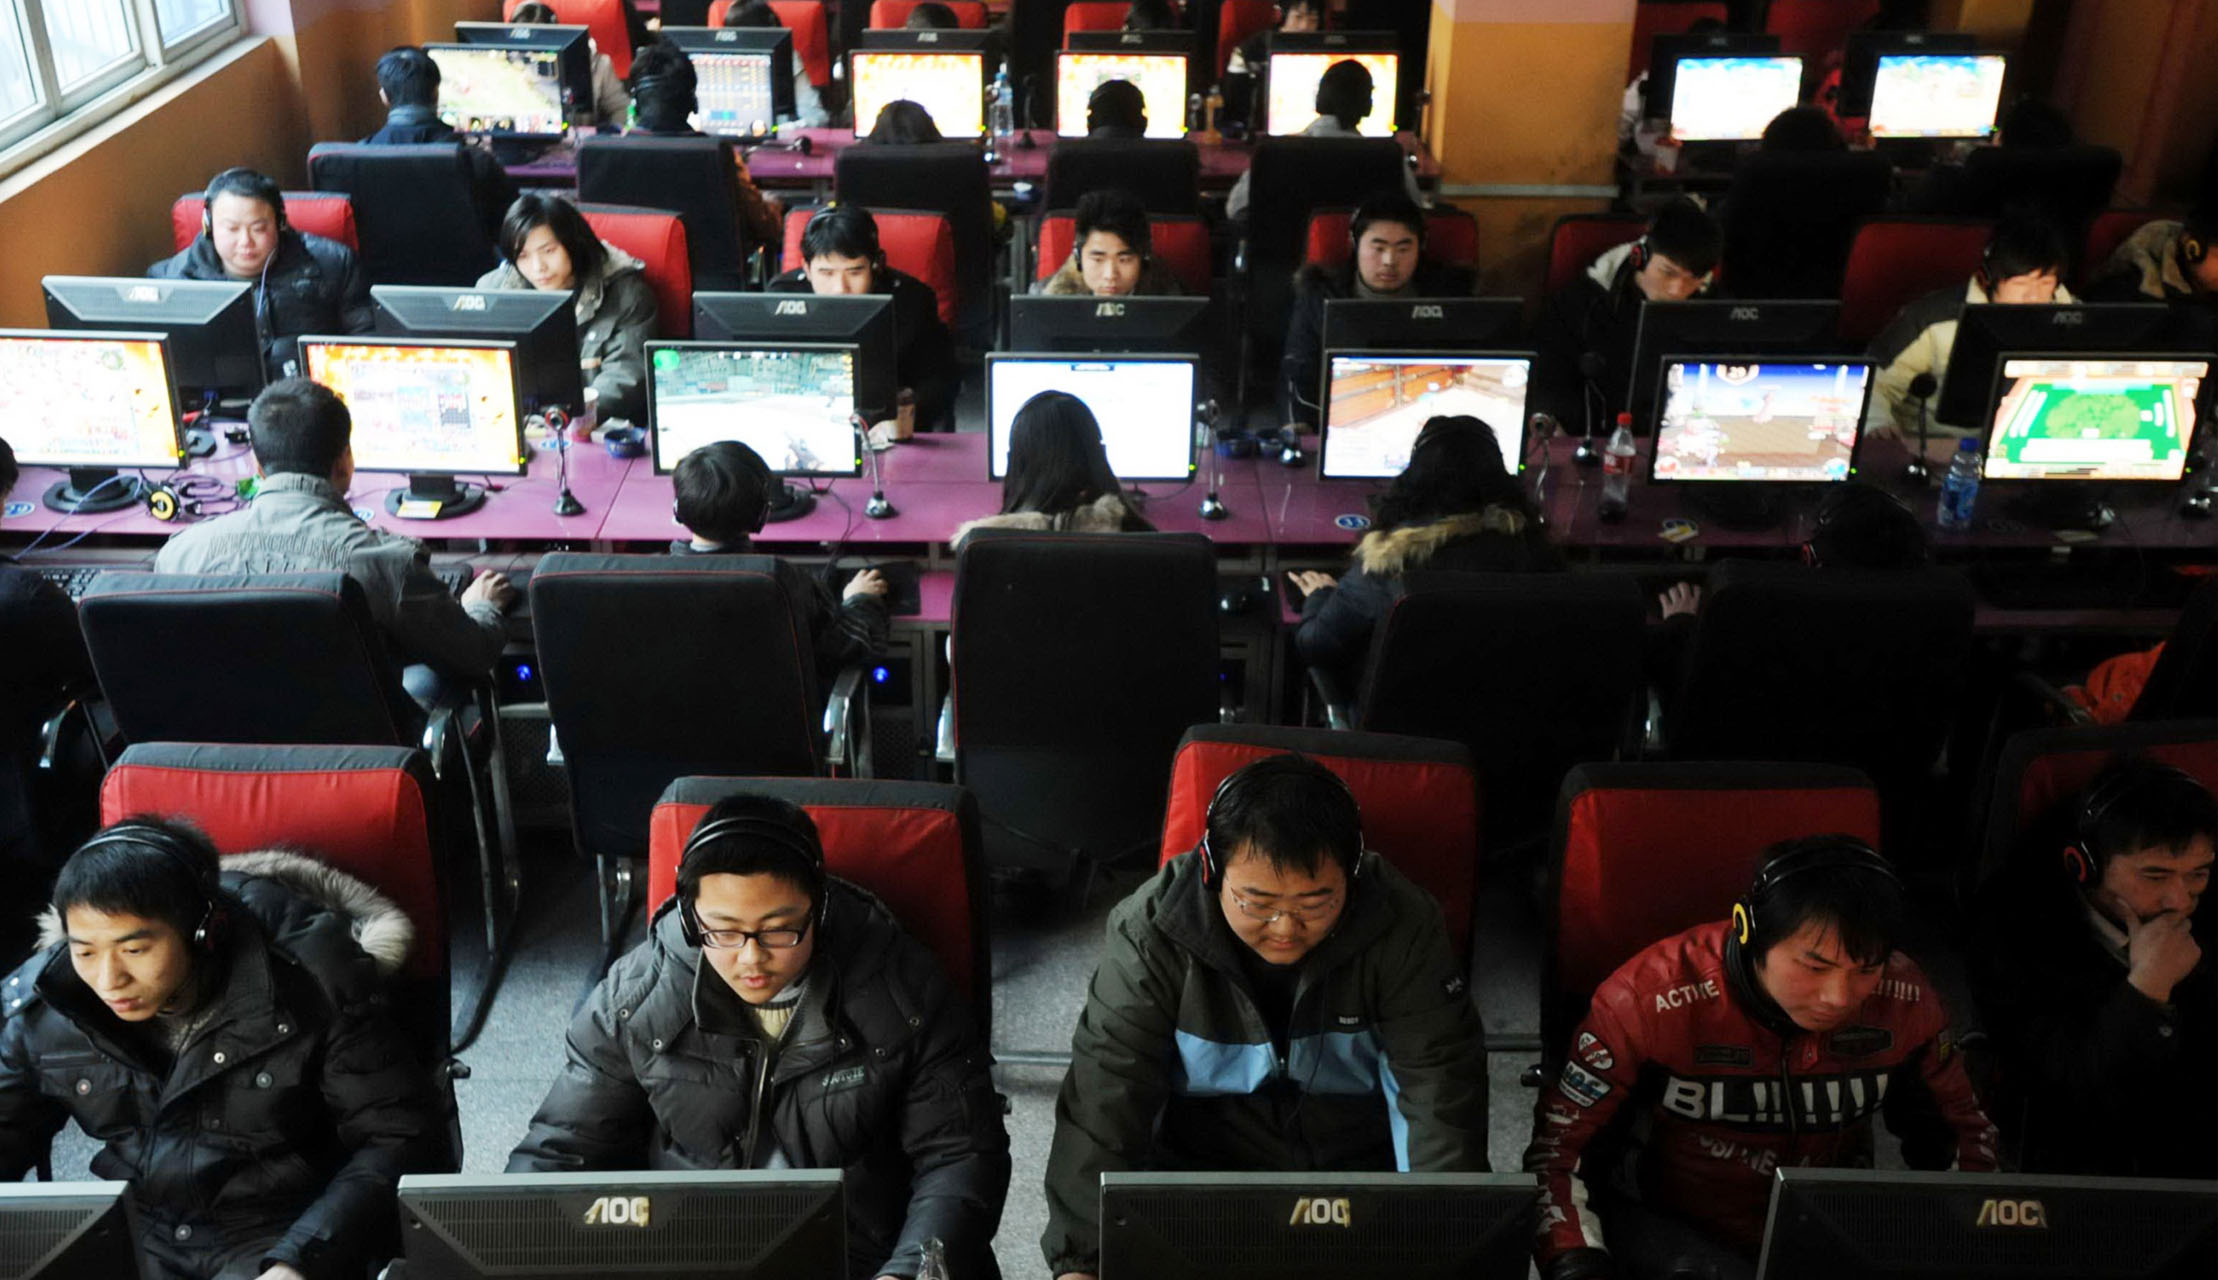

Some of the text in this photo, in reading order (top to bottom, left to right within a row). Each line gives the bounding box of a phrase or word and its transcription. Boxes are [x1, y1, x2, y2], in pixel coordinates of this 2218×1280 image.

[453, 294, 487, 311] AOC
[774, 300, 808, 316] AOC
[1411, 304, 1444, 319] AOC
[1729, 306, 1759, 321] AOC
[2052, 311, 2083, 325] AOC
[584, 1196, 650, 1228] AOC
[1289, 1197, 1351, 1228] AOC
[1976, 1199, 2044, 1227] AOC
